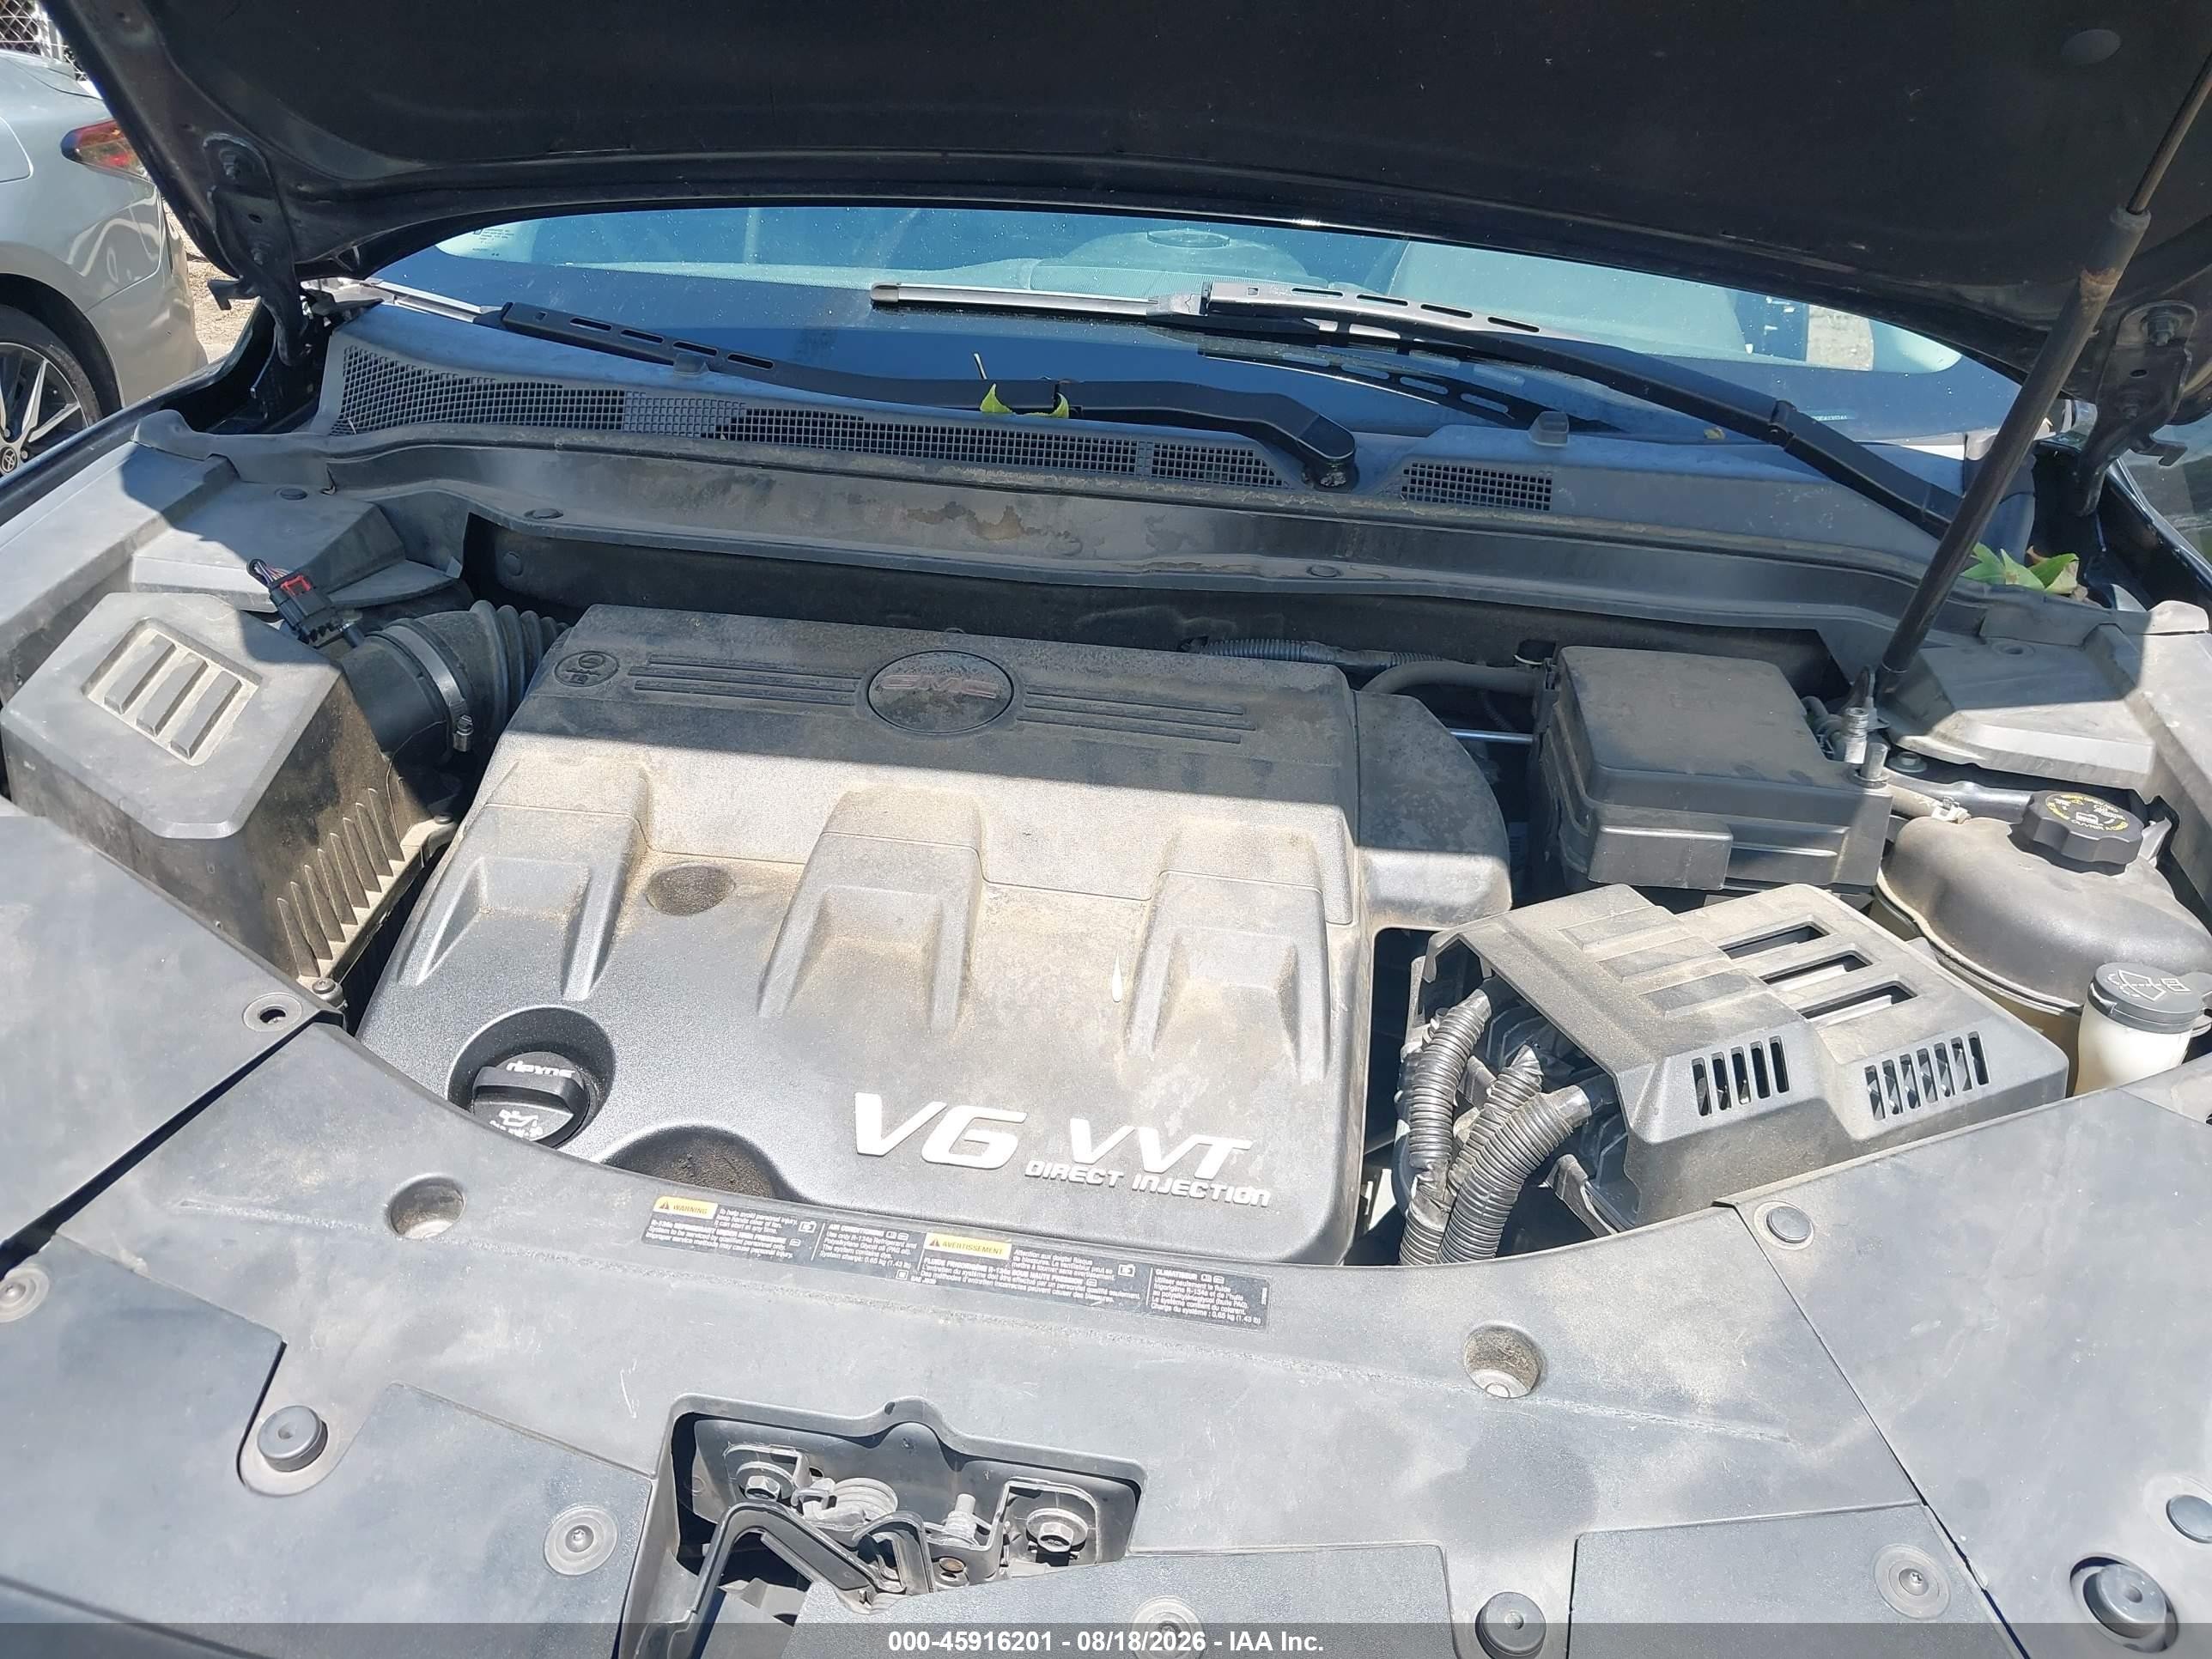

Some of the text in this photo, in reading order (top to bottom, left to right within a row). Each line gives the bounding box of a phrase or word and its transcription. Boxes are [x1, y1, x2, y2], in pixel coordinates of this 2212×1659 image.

[854, 1091, 1252, 1180] V6 VVT
[1024, 1159, 1270, 1207] DIRECT INJECTION
[673, 1205, 708, 1214] WARNING
[841, 1225, 884, 1237] CONDITIONING
[873, 1238, 905, 1248] Refrigerant
[942, 1242, 1004, 1255] AVERTISSEMENT
[1156, 1269, 1198, 1280] CLIMATISEUR
[1176, 1280, 1206, 1289] seulement
